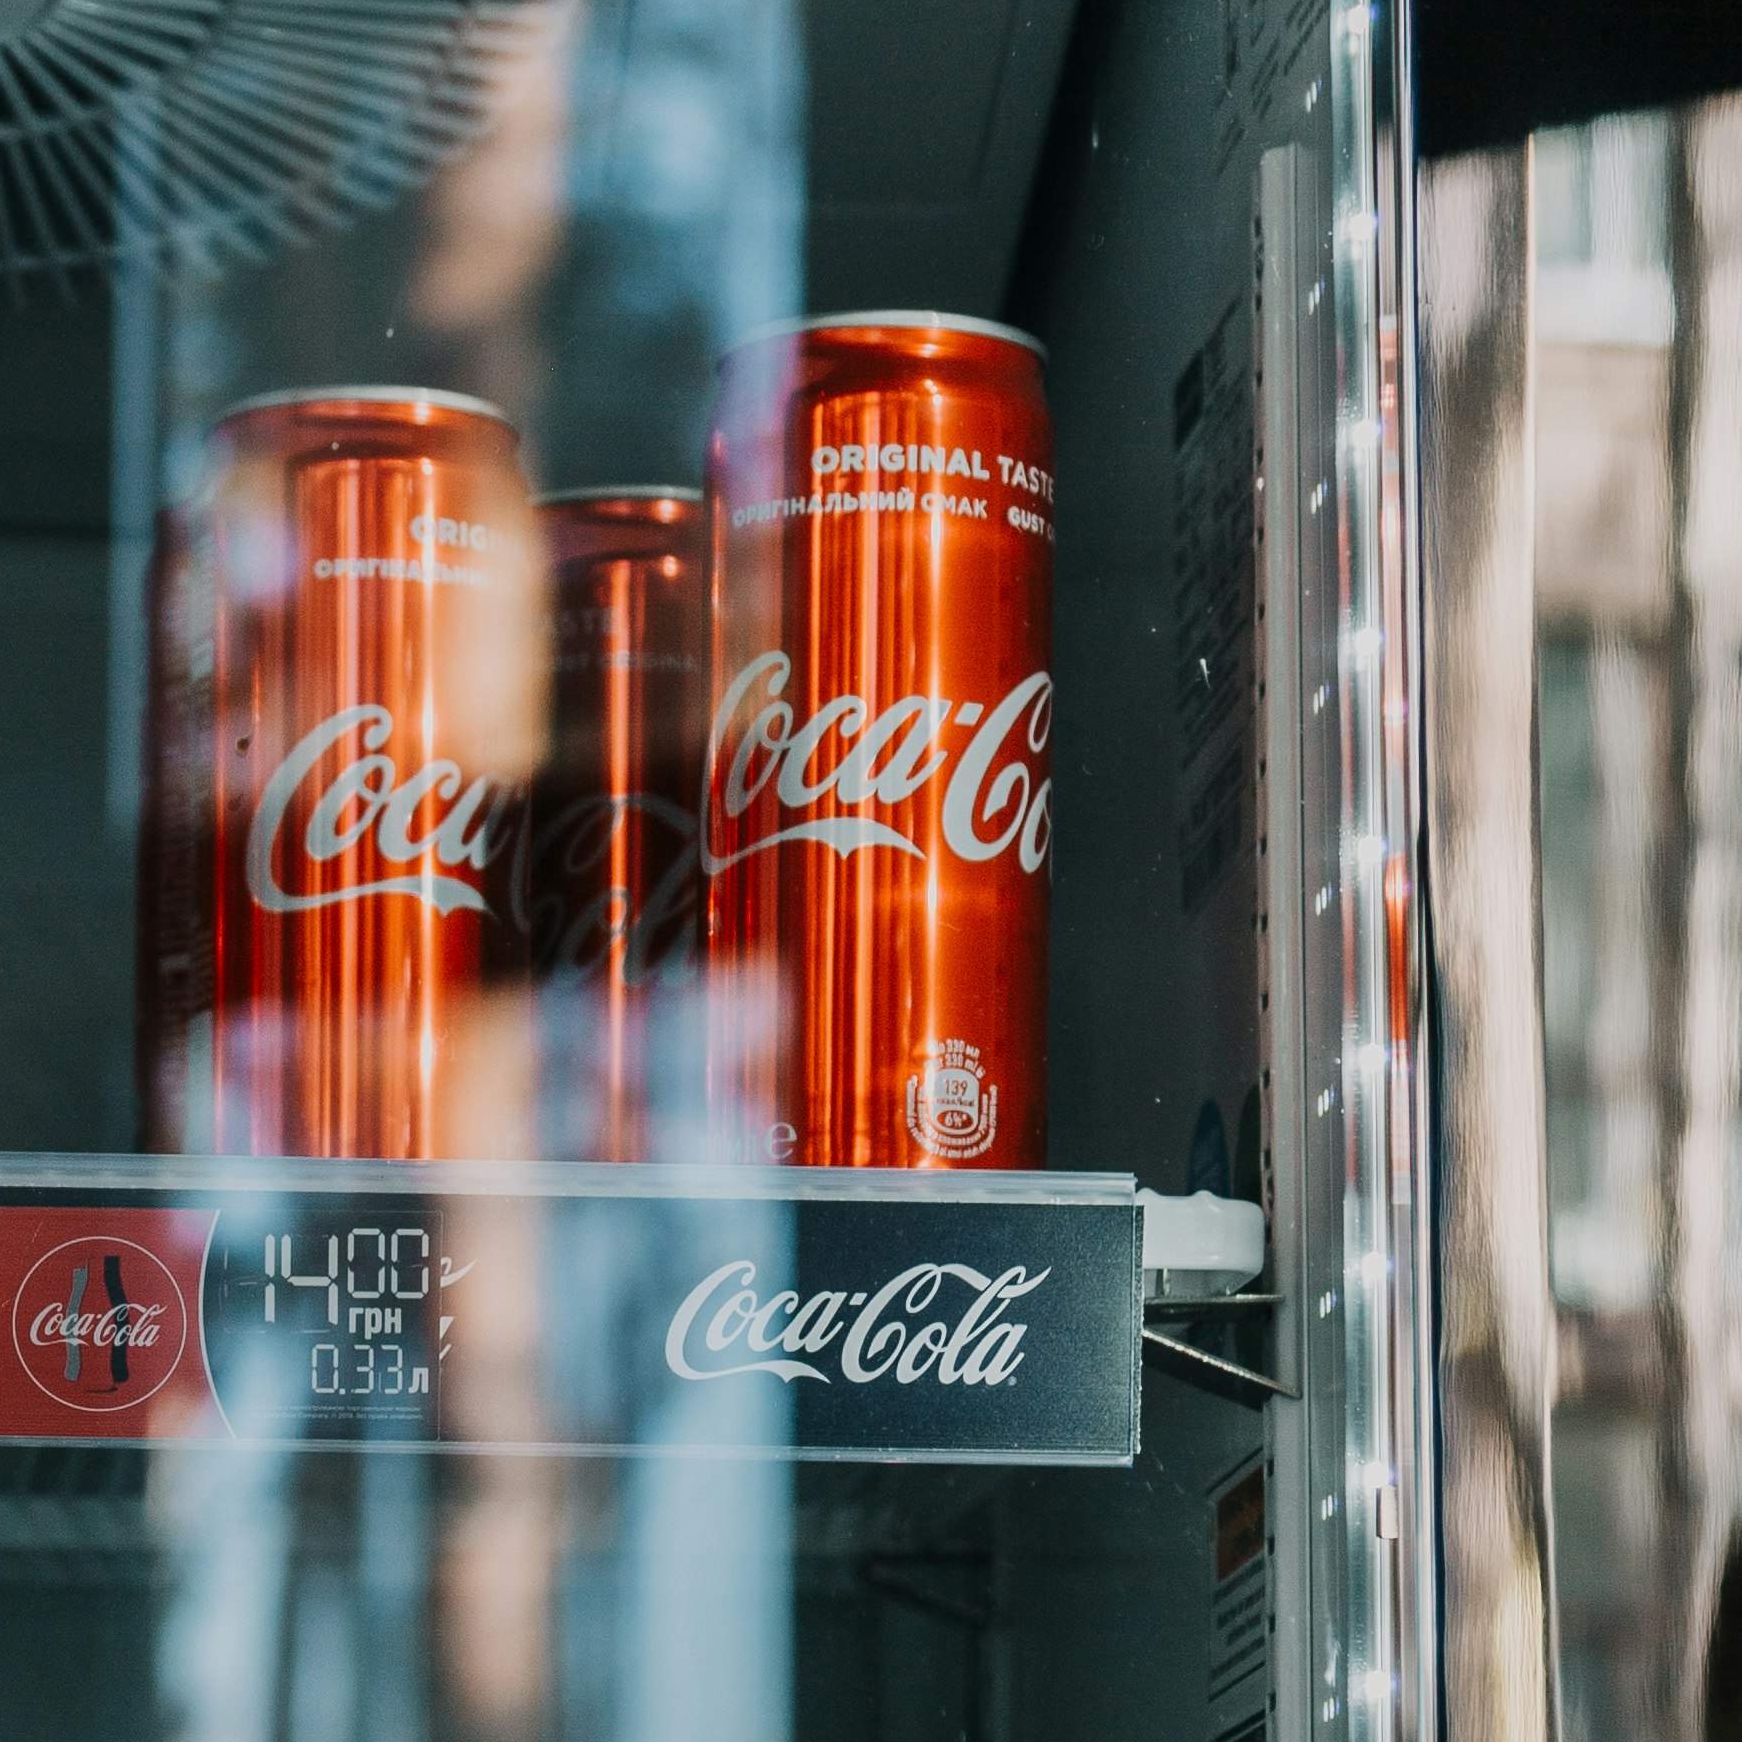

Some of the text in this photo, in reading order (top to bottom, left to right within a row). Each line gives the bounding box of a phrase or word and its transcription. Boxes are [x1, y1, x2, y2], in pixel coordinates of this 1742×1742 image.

[811, 442, 991, 481] ORIGINAL
[731, 484, 916, 529] ОРИГІНАЛЬНИЙ
[920, 491, 989, 520] СМАК
[944, 1079, 969, 1097] 139
[29, 1301, 168, 1348] Coca-Cola
[348, 1307, 402, 1340] грн
[664, 1259, 1052, 1386] Coca-Cola
